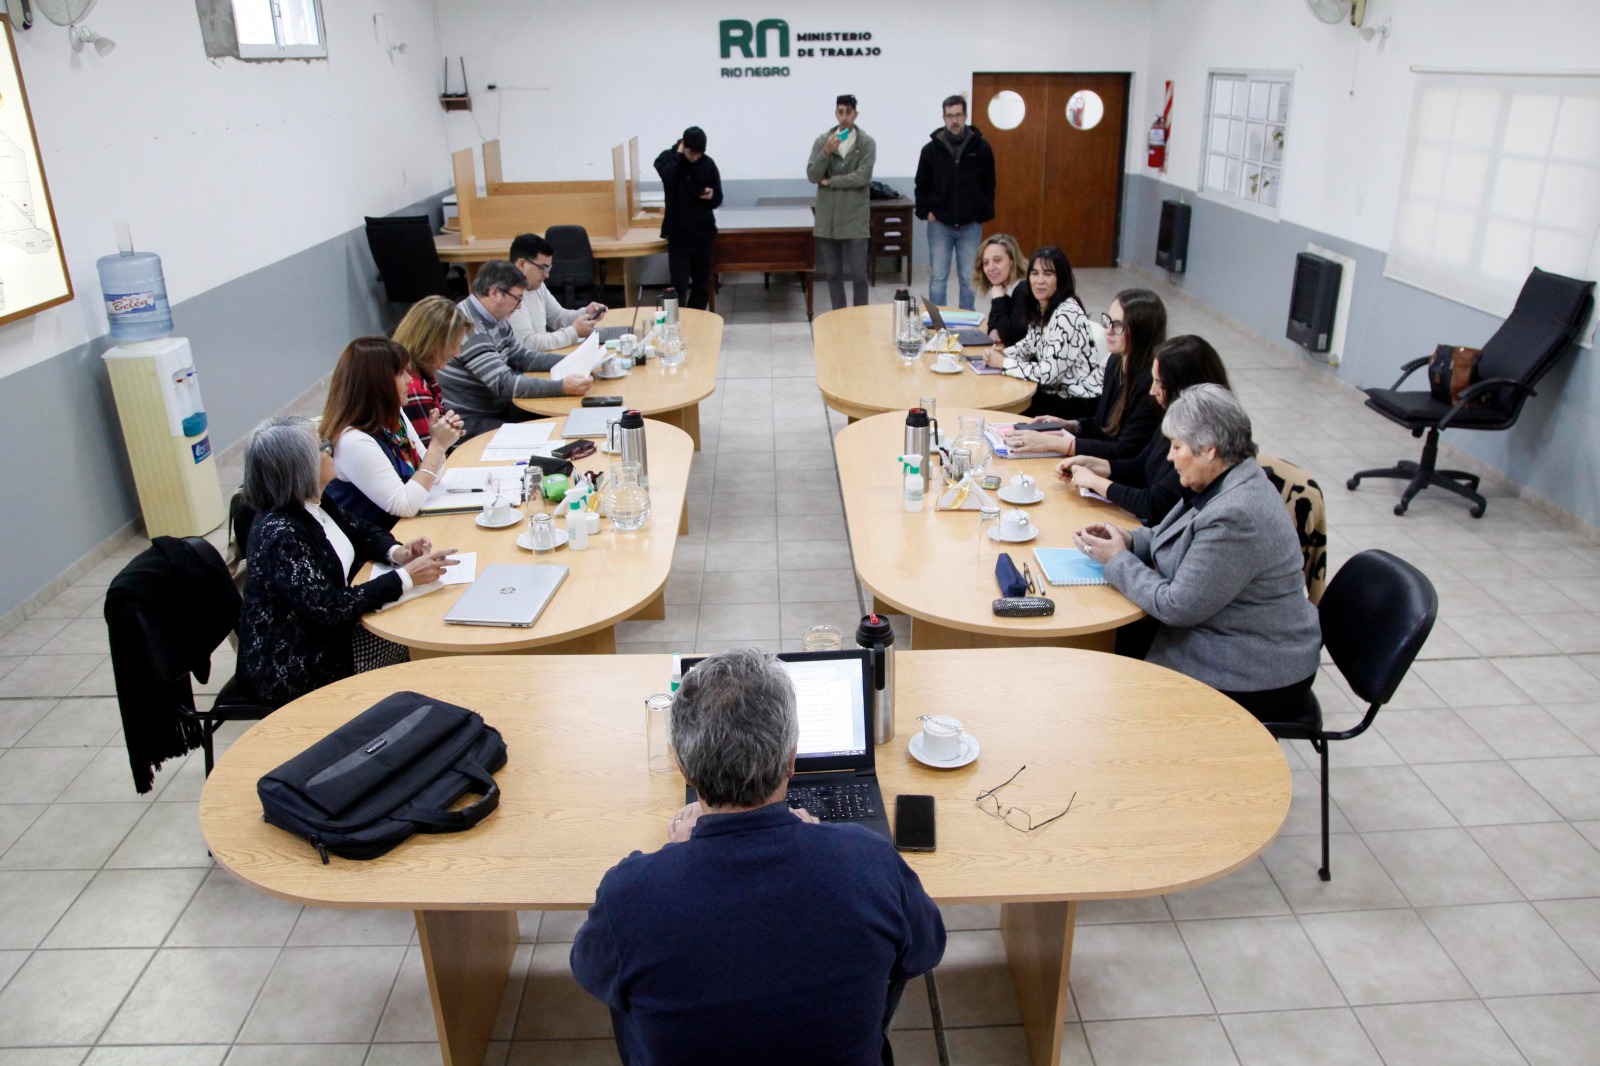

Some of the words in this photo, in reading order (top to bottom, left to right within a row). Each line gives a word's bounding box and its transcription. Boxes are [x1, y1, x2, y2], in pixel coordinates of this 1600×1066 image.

[797, 32, 872, 42] MINISTERIO
[797, 48, 815, 57] DE
[820, 47, 881, 57] TRABAJO
[721, 67, 743, 78] RIO
[745, 66, 790, 77] NEGRO
